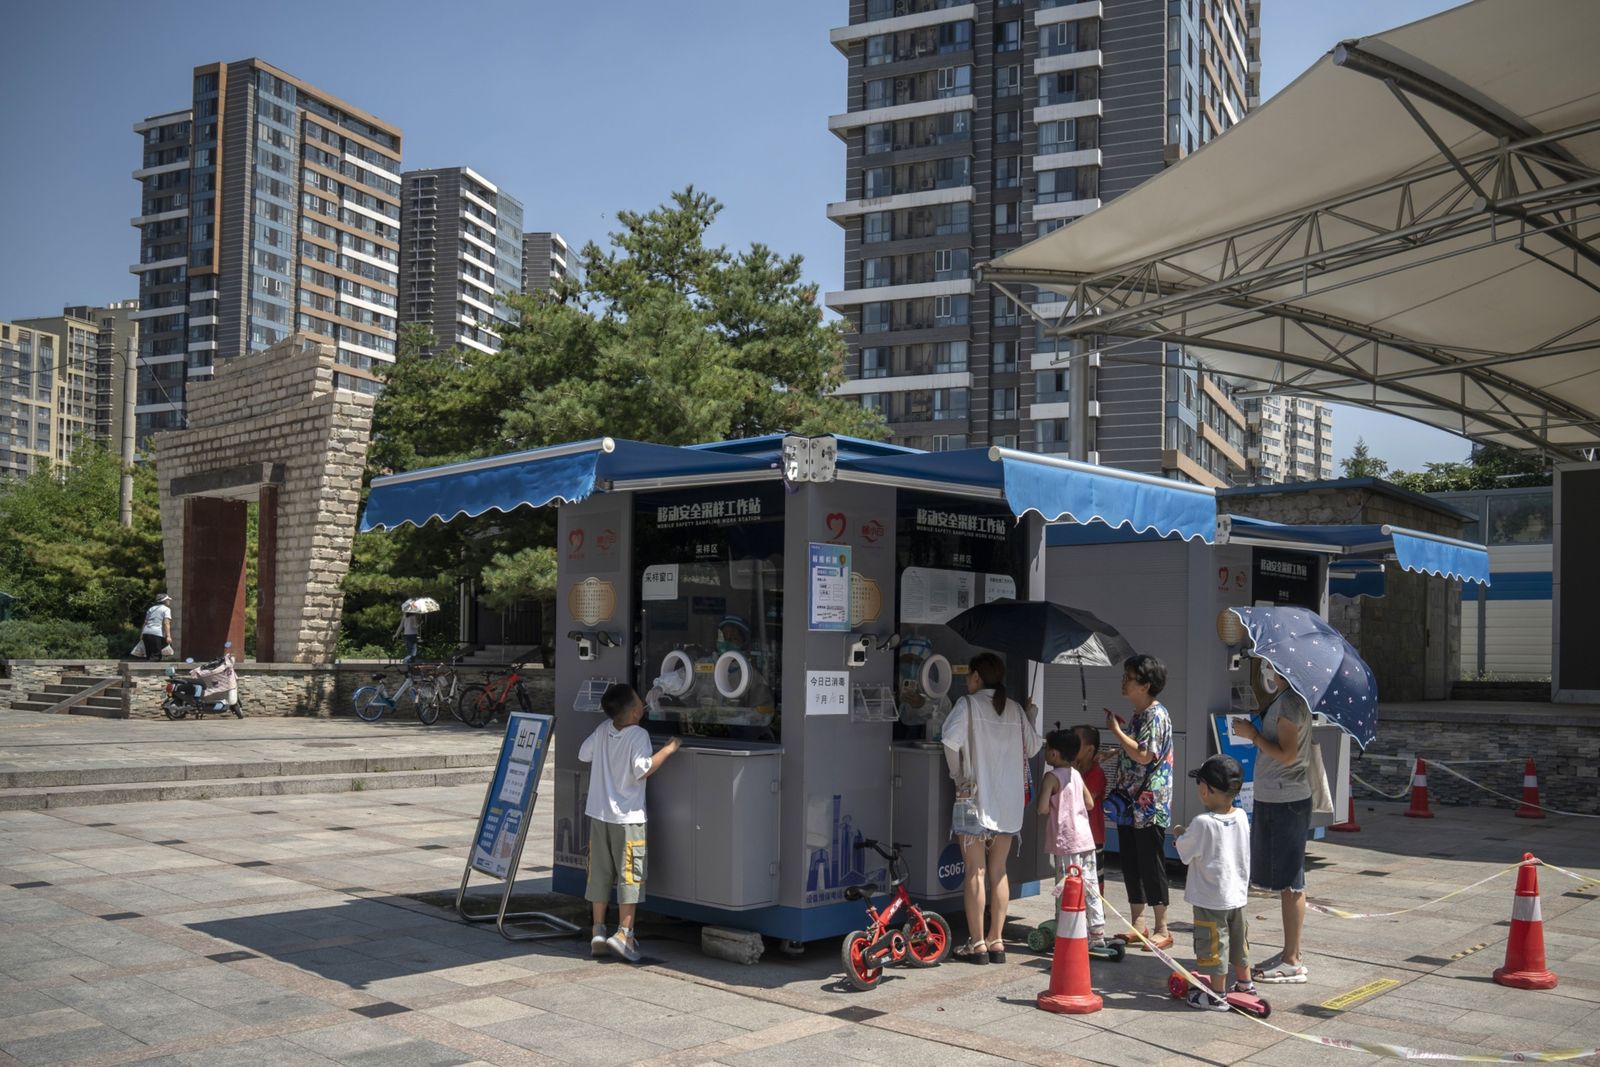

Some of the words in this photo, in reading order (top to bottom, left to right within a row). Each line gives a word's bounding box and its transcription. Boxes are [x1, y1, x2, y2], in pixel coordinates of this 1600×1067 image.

[657, 497, 761, 522] 移动安全采样工作站
[916, 508, 1006, 534] 移动安全采样工作站
[695, 543, 718, 553] 采样区
[645, 572, 673, 582] 采样窗口
[810, 676, 845, 687] 今日已消毒
[517, 729, 536, 749] 出口
[938, 861, 965, 879] CS067
